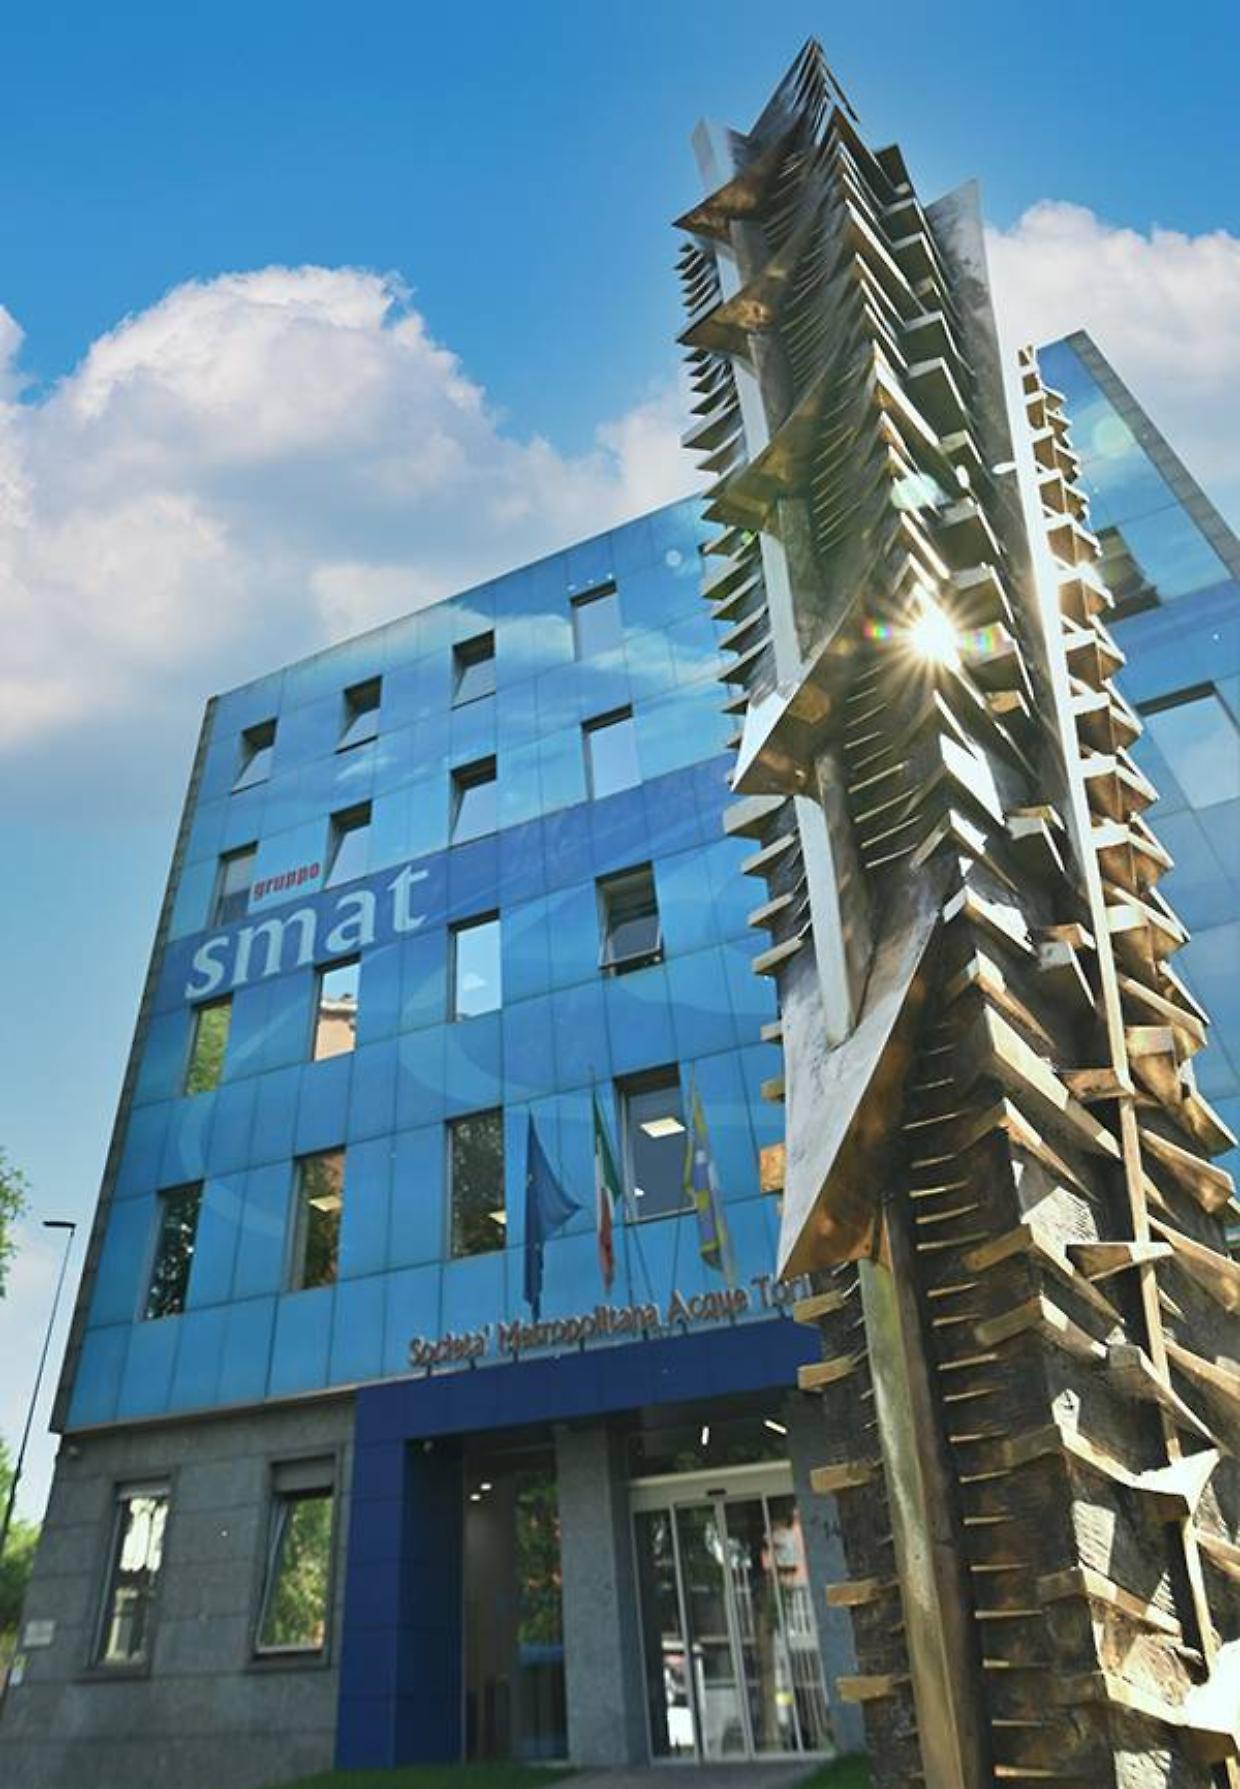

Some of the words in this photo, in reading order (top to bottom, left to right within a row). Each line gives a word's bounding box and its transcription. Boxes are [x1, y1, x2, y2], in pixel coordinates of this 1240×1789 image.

[254, 863, 320, 900] gruppo
[185, 865, 429, 999] smat
[497, 1304, 662, 1354] Metropolitana
[667, 1288, 750, 1324] Acque
